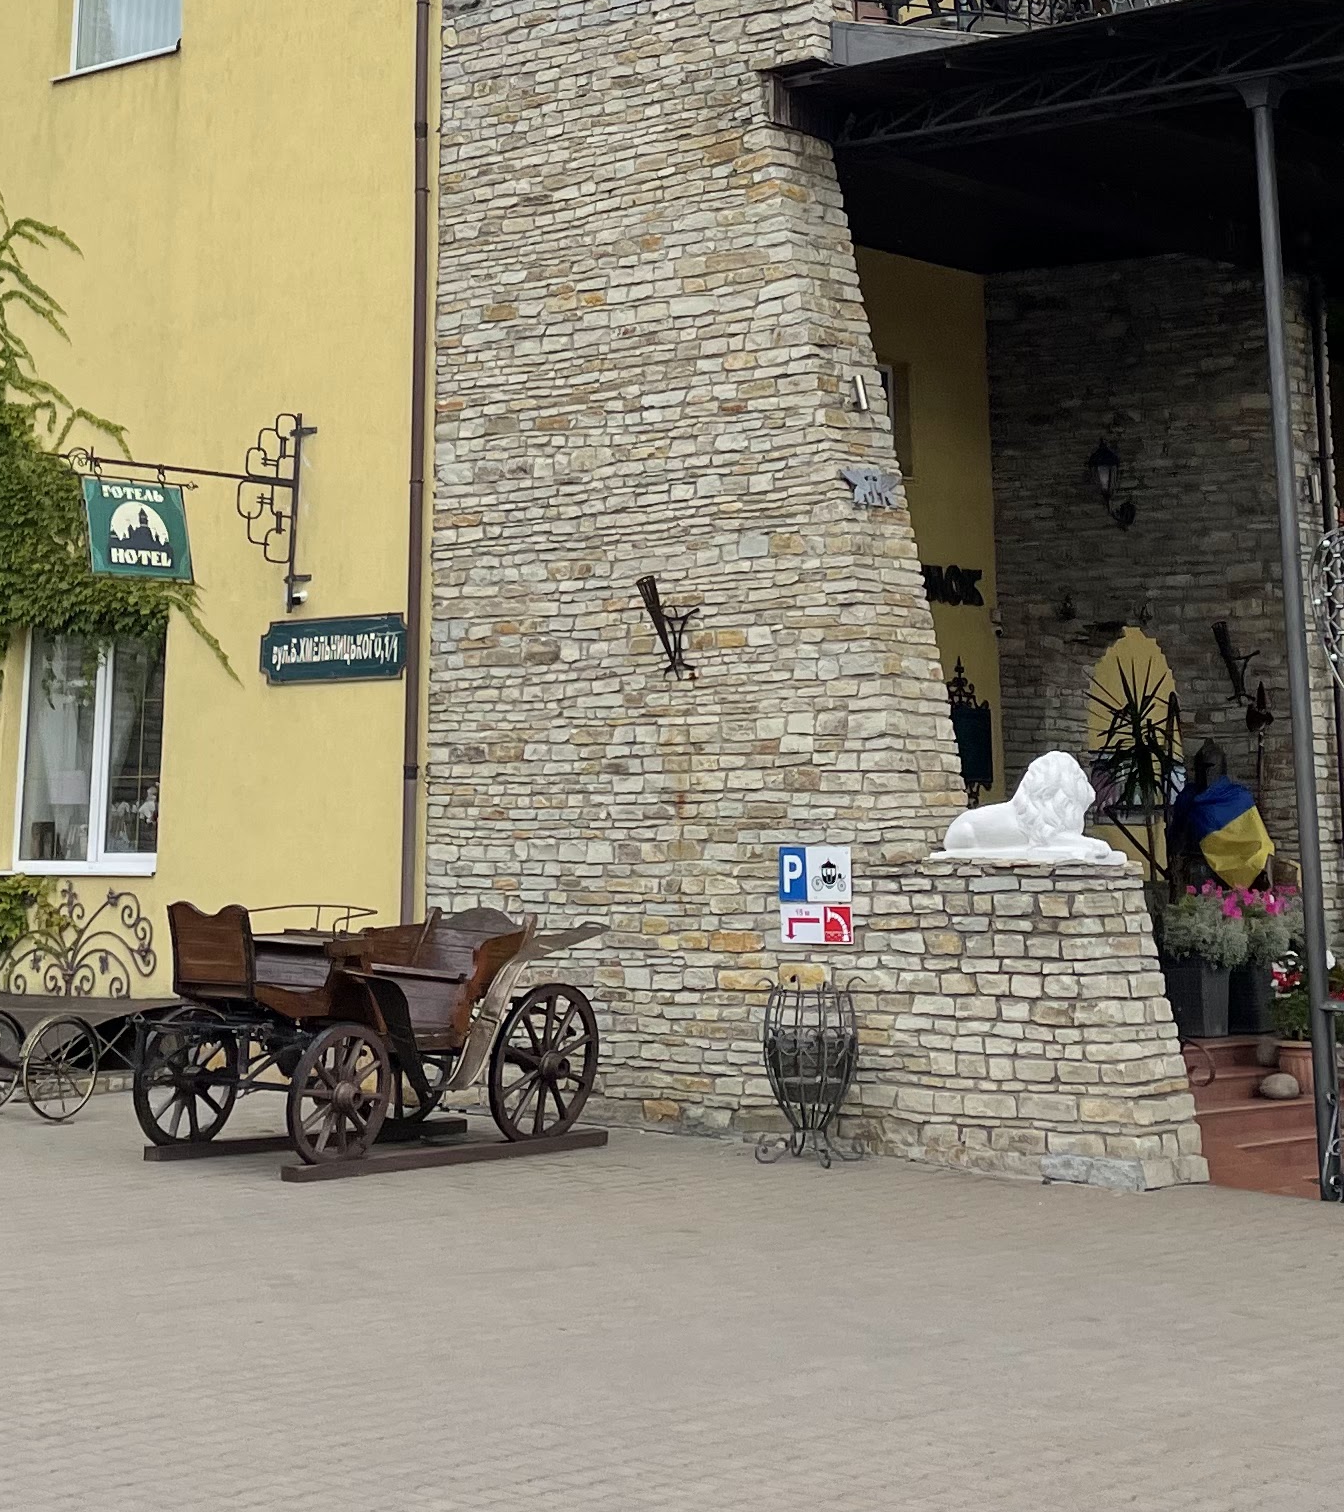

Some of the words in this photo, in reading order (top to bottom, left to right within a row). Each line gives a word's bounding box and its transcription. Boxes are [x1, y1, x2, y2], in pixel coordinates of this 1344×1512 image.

[101, 484, 164, 503] ГОТЕЛЬ
[110, 548, 172, 568] HOTEL
[783, 854, 802, 893] P
